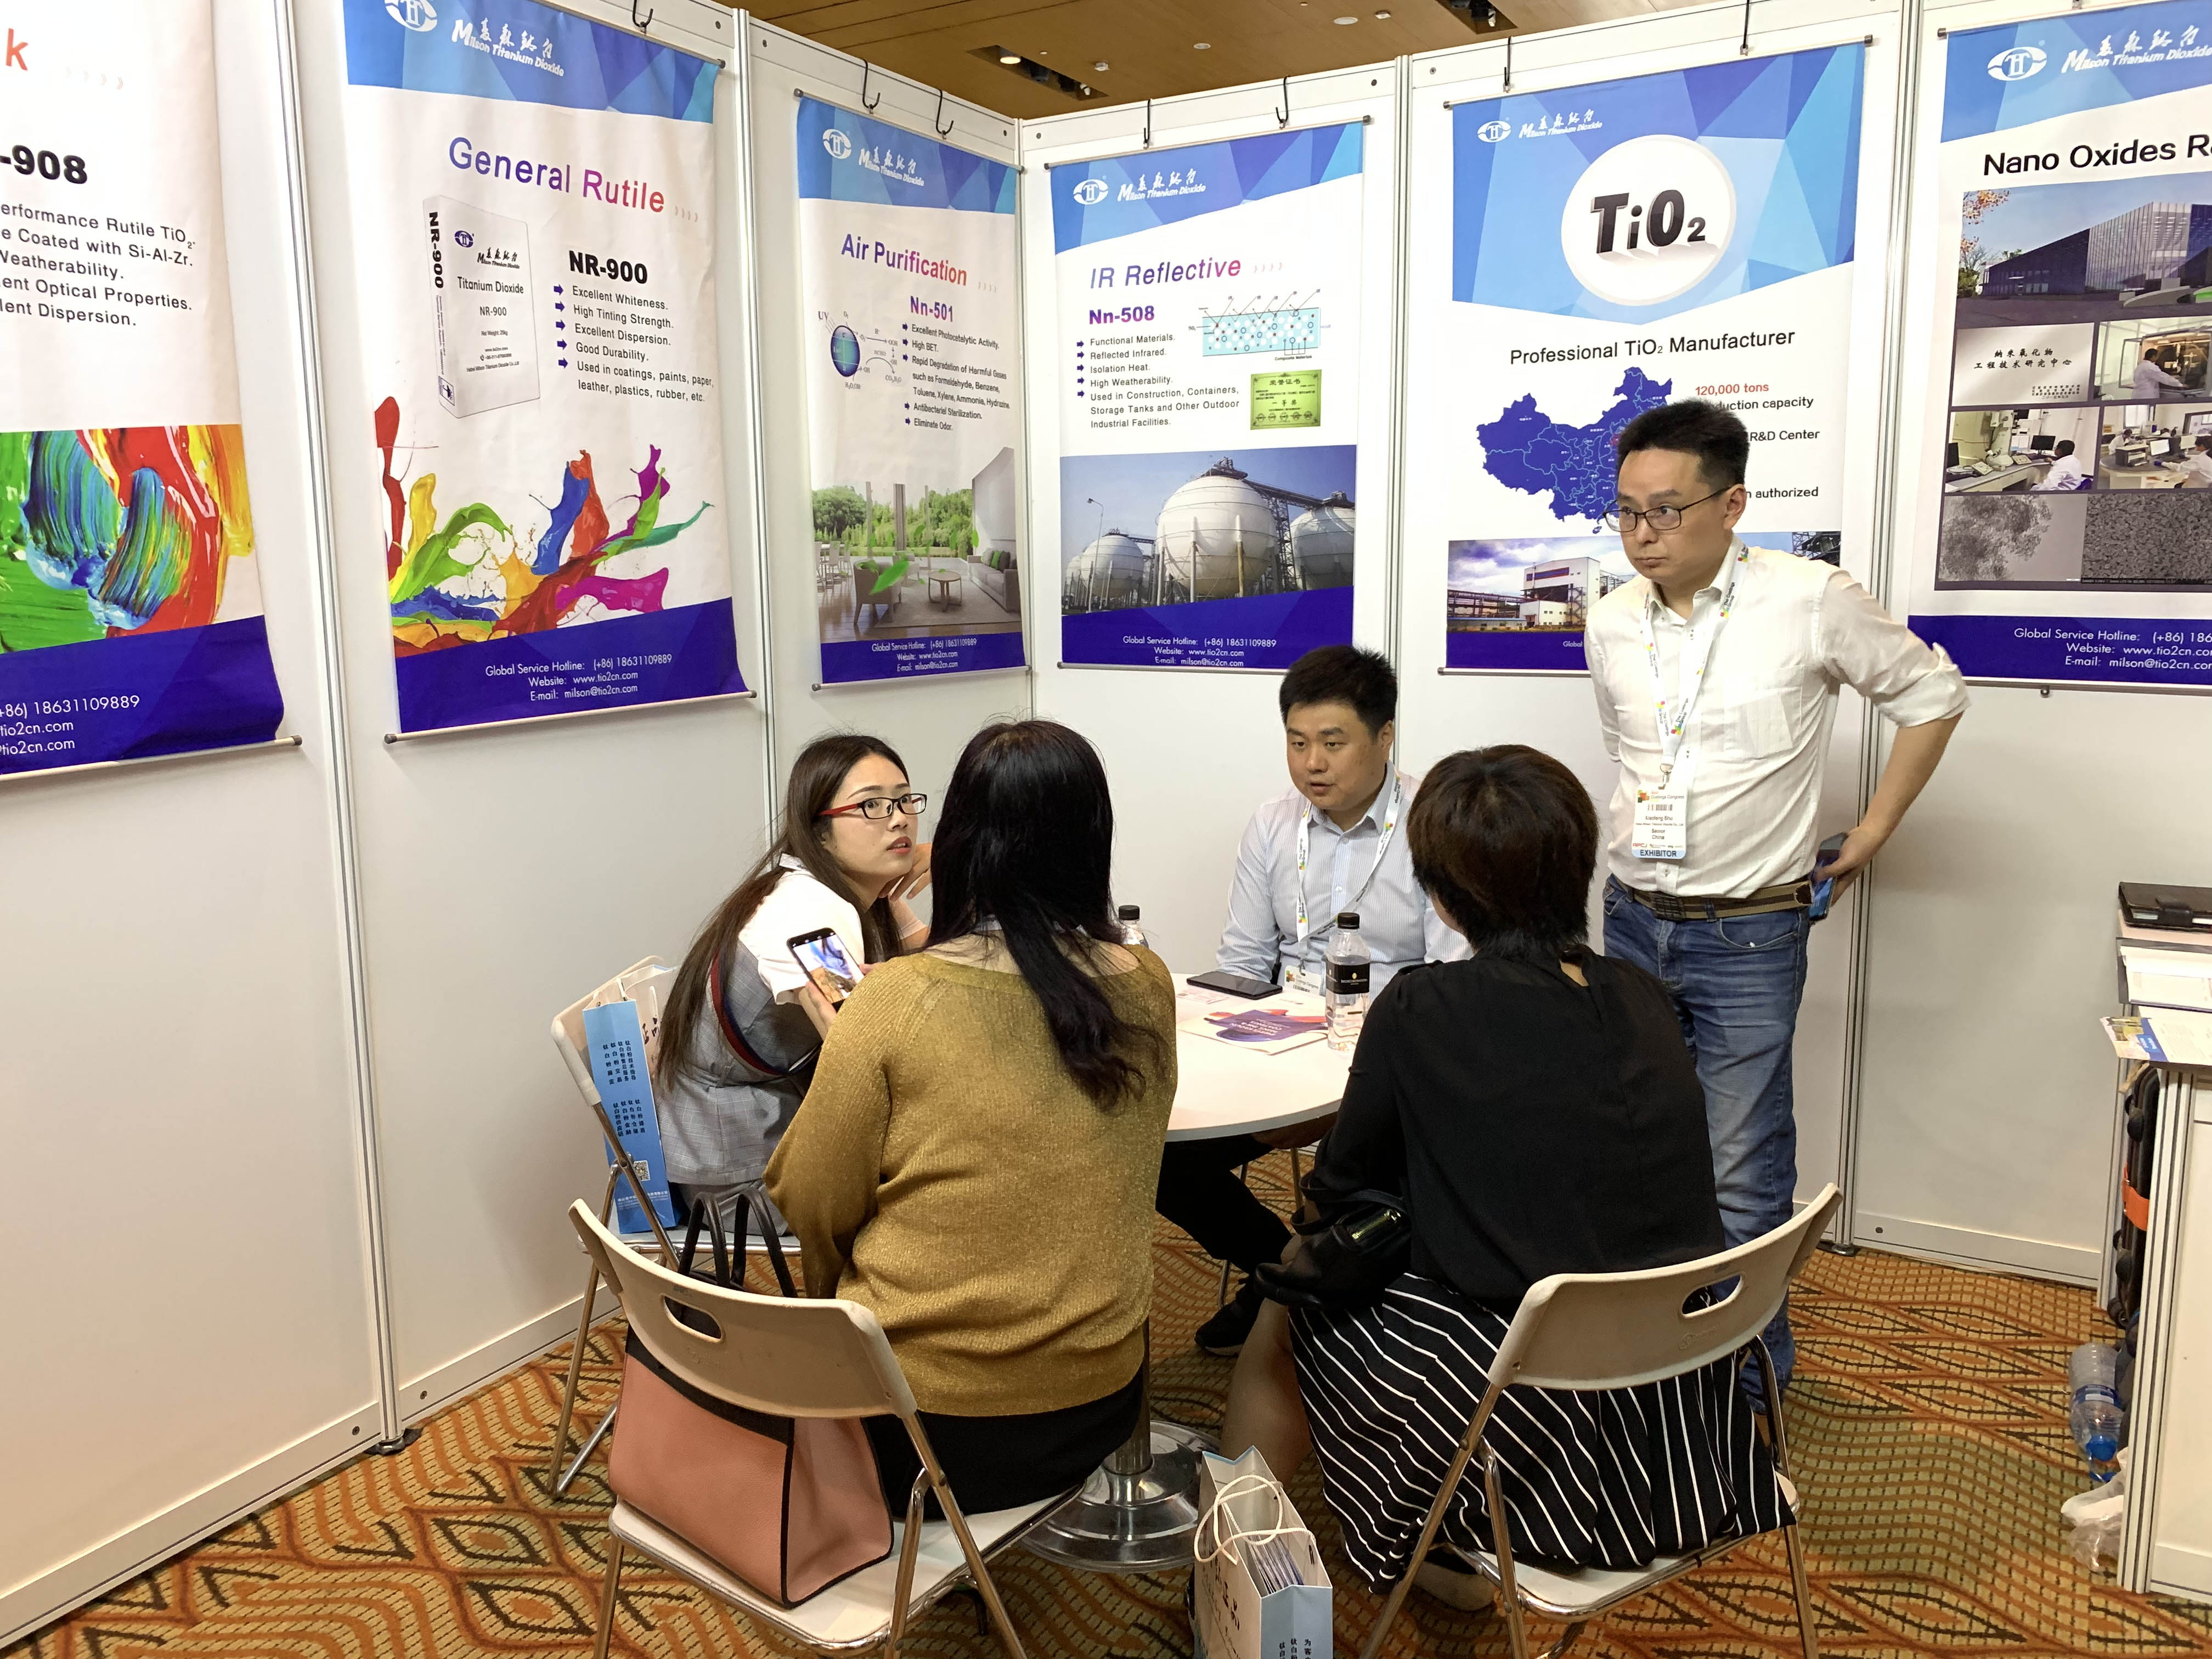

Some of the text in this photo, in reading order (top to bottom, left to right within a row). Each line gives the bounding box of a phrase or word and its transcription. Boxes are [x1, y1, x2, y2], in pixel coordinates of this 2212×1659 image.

[6, 28, 28, 70] k
[452, 20, 564, 77] Milson Titanium Dioxide
[2061, 45, 2212, 73] Milson Titanium Dioxide
[1984, 134, 2212, 176] Nano Oxides R
[450, 137, 664, 212] General Rutile
[1147, 186, 1177, 199] Titanium
[1180, 183, 1206, 194] Dioxide
[107, 218, 154, 236] Rutile
[19, 229, 192, 266] Coated with Si-Al-Zr.
[428, 212, 444, 289] NR-900
[569, 251, 647, 284] NR-900
[842, 234, 966, 285] Air Purification
[1091, 257, 1240, 289] IR Reflective
[458, 276, 523, 294] Titanium Dioxide
[36, 279, 96, 298] Optical
[105, 287, 191, 310] Properties.
[573, 285, 668, 309] Excellent Whiteness.
[38, 303, 136, 325] Dispersion.
[480, 307, 506, 315] NR-900
[574, 304, 673, 329] High Tinting Strength.
[911, 296, 952, 322] Nn-501
[1090, 306, 1154, 324] Nn-508
[575, 323, 670, 345] Excellent Dispersion.
[912, 324, 999, 350] Excellent Photocatalytic Activity.
[1091, 333, 1175, 346] Functional Materials.
[577, 342, 648, 362] Good Durability.
[912, 340, 938, 352] High BET.
[1091, 347, 1166, 360] Reflected Infrared.
[1511, 342, 1617, 364] Professional
[1670, 332, 1795, 352] Manufacturer
[578, 361, 713, 387] Used in coatings, paints, paper,
[912, 356, 928, 366] Rapid
[930, 359, 959, 371] Degradation
[969, 366, 991, 376] Harmful
[1091, 363, 1150, 374] Isolation Heat.
[579, 380, 705, 402] leather, plastics, rubber, etc.
[935, 375, 973, 390] Formaldehyde,
[975, 382, 1000, 393] Benzene,
[1091, 375, 1173, 389] High Weatherability.
[1696, 383, 1769, 396] 120,000 tons
[913, 387, 985, 405] Toluene, Xylene, Ammonia,
[1091, 385, 1239, 401] Used in Construction, Containers,
[914, 403, 982, 419] Antibacterial Sterilization.
[1091, 399, 1239, 416] Storage Tanks and Other Outdoor
[1763, 397, 1813, 410] capacity
[915, 418, 952, 430] Eliminate Odor.
[1091, 417, 1171, 428] Industrial Facilities.
[1750, 430, 1820, 441] R&D Center
[1756, 487, 1818, 498] authorized
[1205, 638, 1223, 647] (+86)
[1227, 639, 1276, 647] 18631109889
[2015, 628, 2051, 638] Global
[2055, 629, 2094, 639] Service
[2098, 630, 2140, 641] Hotline:
[2153, 632, 2183, 644] (+86)
[872, 643, 890, 651] Global
[930, 640, 944, 650] (+86)
[2067, 643, 2212, 656] Website: www.tio2cn.co
[486, 654, 672, 676] Global Service Hotline: (+86) 18631109889
[1181, 658, 1244, 667] milson@tio2cn.com
[2066, 656, 2101, 665] E-mail:
[528, 672, 637, 686] Website: www.tio2cn.com
[531, 685, 637, 701] E-mail: milson@tio2cn.com
[35, 695, 139, 714] 18631109889
[0, 741, 75, 755] tio2cn.com
